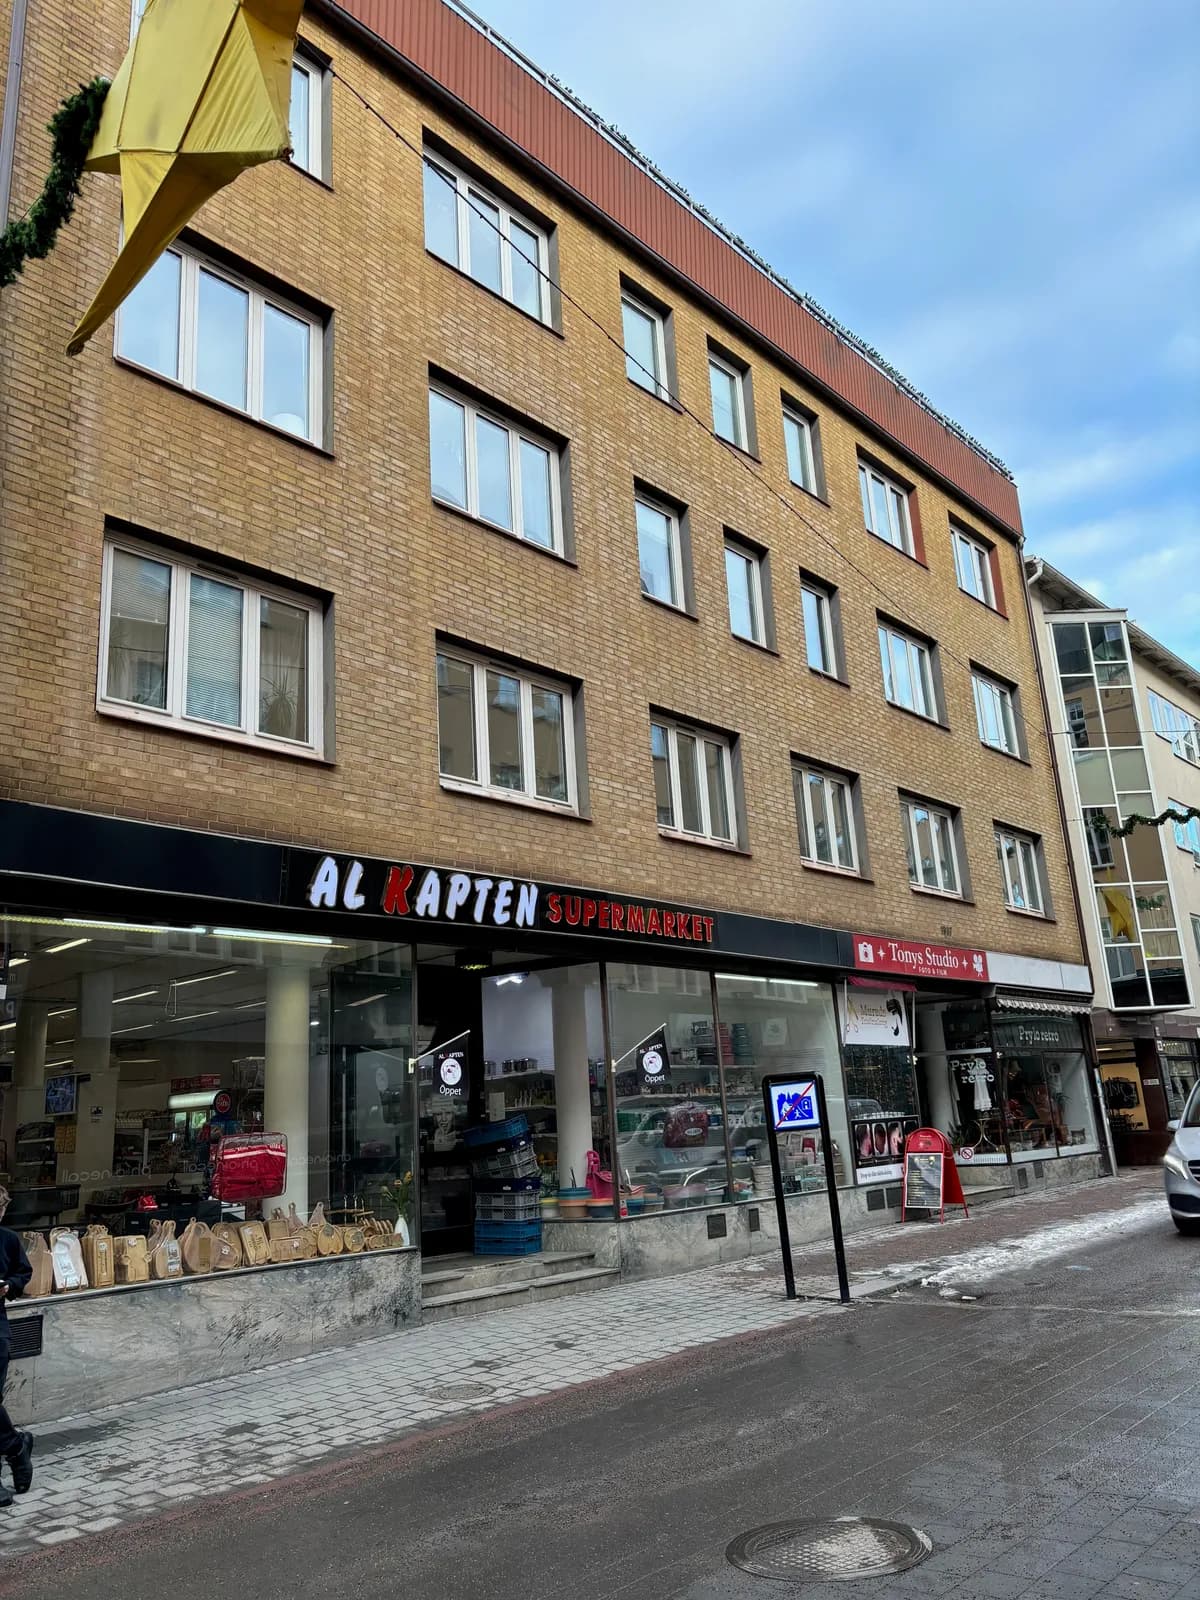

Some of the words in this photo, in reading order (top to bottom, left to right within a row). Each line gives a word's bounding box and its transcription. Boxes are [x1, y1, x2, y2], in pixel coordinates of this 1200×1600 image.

[309, 856, 365, 910] AL
[382, 865, 538, 928] KAPTEN
[547, 893, 714, 943] SUPERMARKET
[888, 942, 923, 969] Tonys
[925, 947, 959, 969] Studio
[644, 1074, 665, 1084] Öppet
[961, 1074, 994, 1083] reo
[439, 1084, 462, 1096] Öppet
